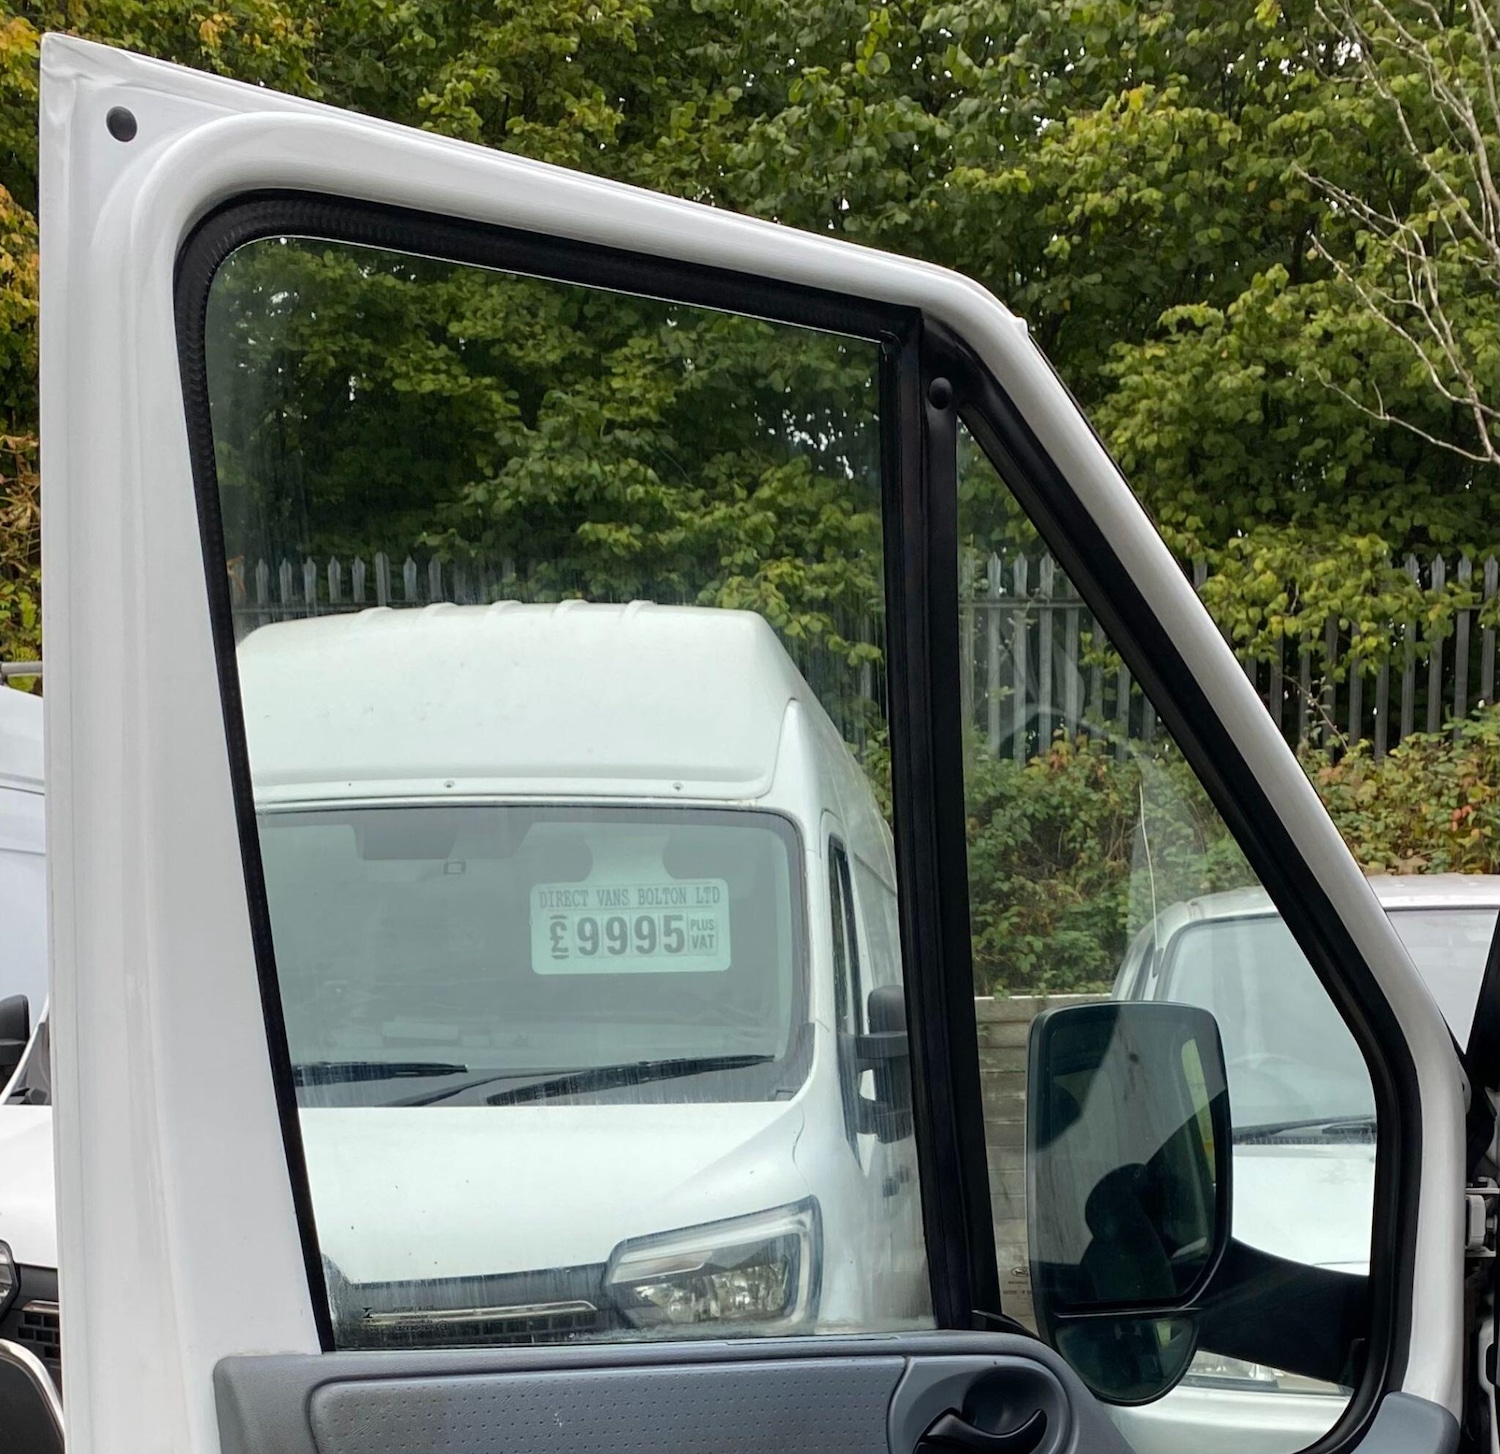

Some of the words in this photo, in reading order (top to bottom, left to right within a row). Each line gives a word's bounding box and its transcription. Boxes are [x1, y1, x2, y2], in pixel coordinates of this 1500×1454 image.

[539, 890, 589, 908] DIRECT
[597, 888, 630, 906] VANS
[638, 887, 687, 906] BOLTON
[696, 886, 720, 904] LTD
[690, 918, 714, 931] PLUS
[549, 914, 686, 959] £9995
[692, 934, 714, 949] VAT
